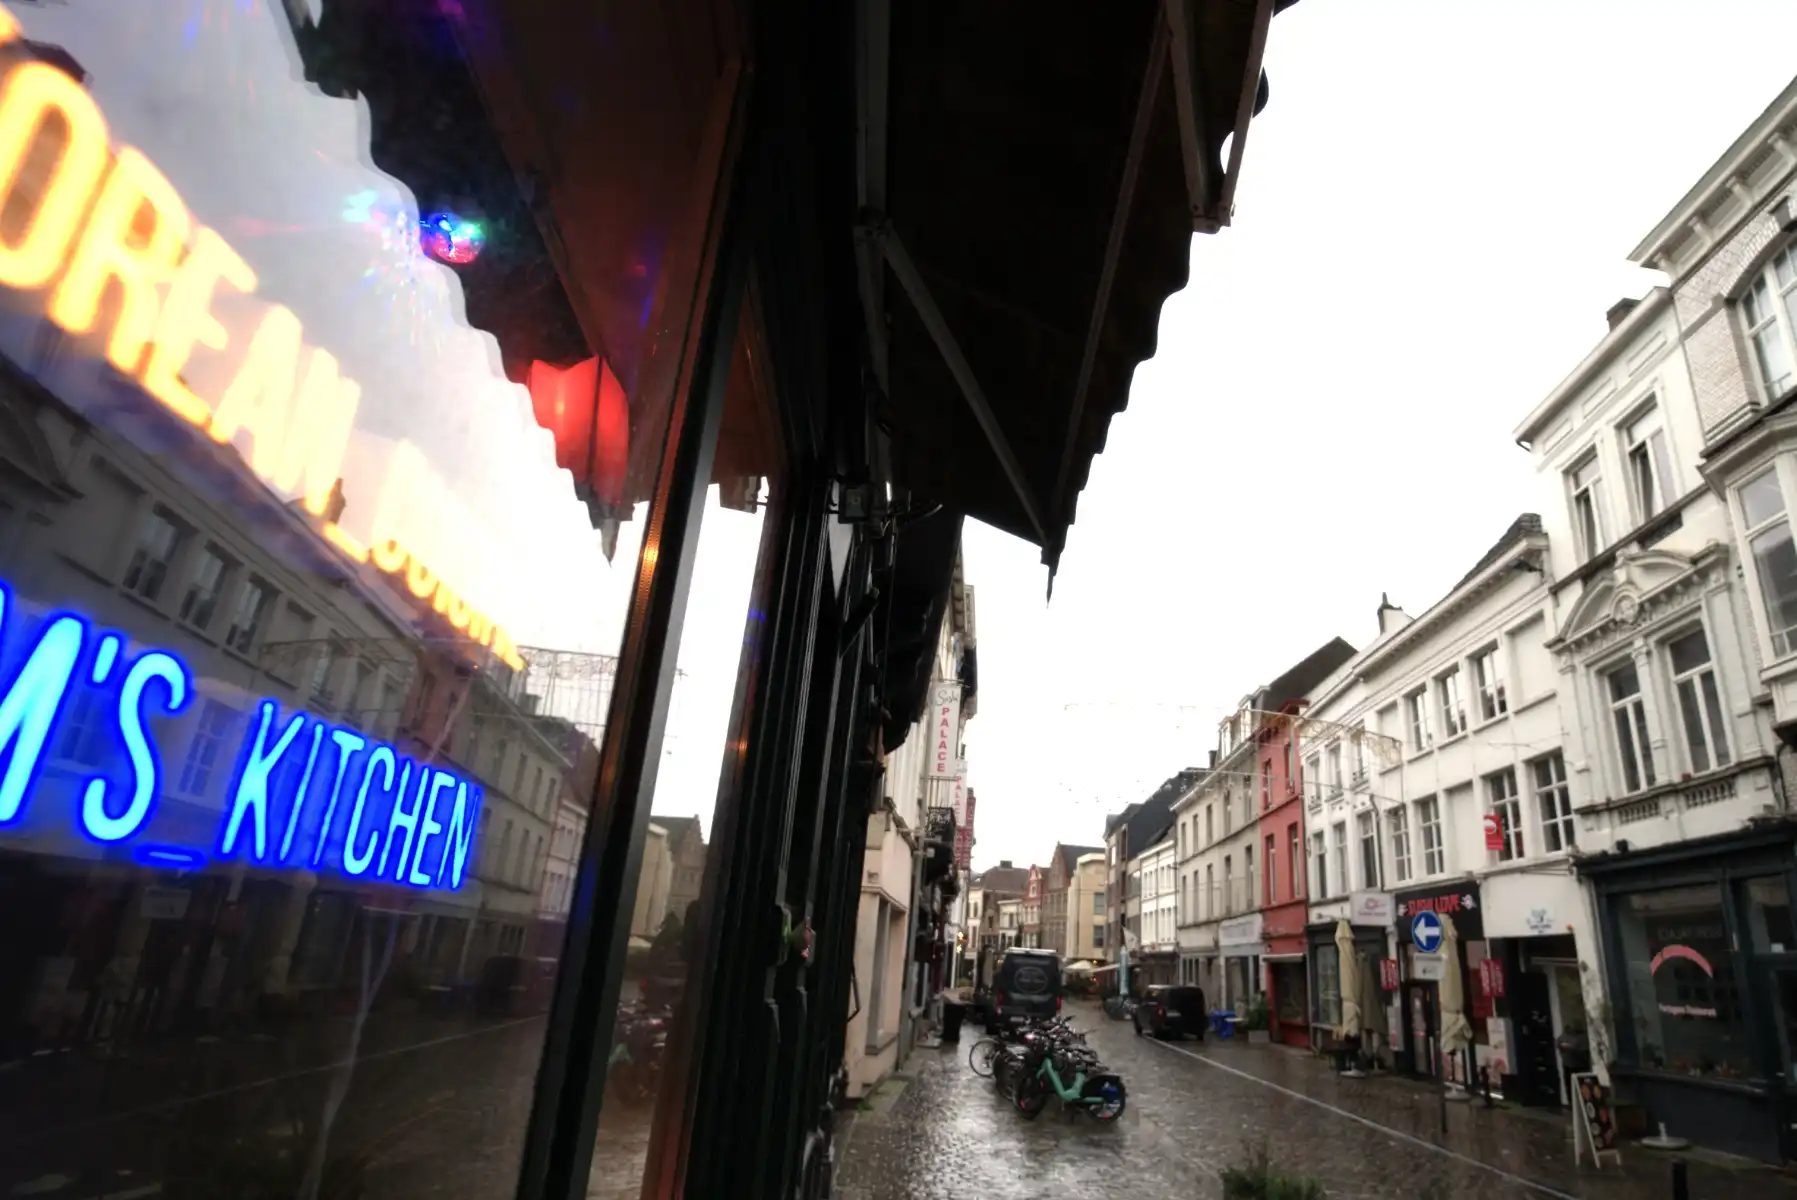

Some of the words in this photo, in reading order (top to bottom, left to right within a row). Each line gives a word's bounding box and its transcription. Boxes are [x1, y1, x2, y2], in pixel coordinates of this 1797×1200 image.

[0, 5, 361, 516] OREAN
[222, 702, 479, 890] KITCHEN
[937, 707, 950, 773] PALACE
[1435, 894, 1460, 913] LOVE
